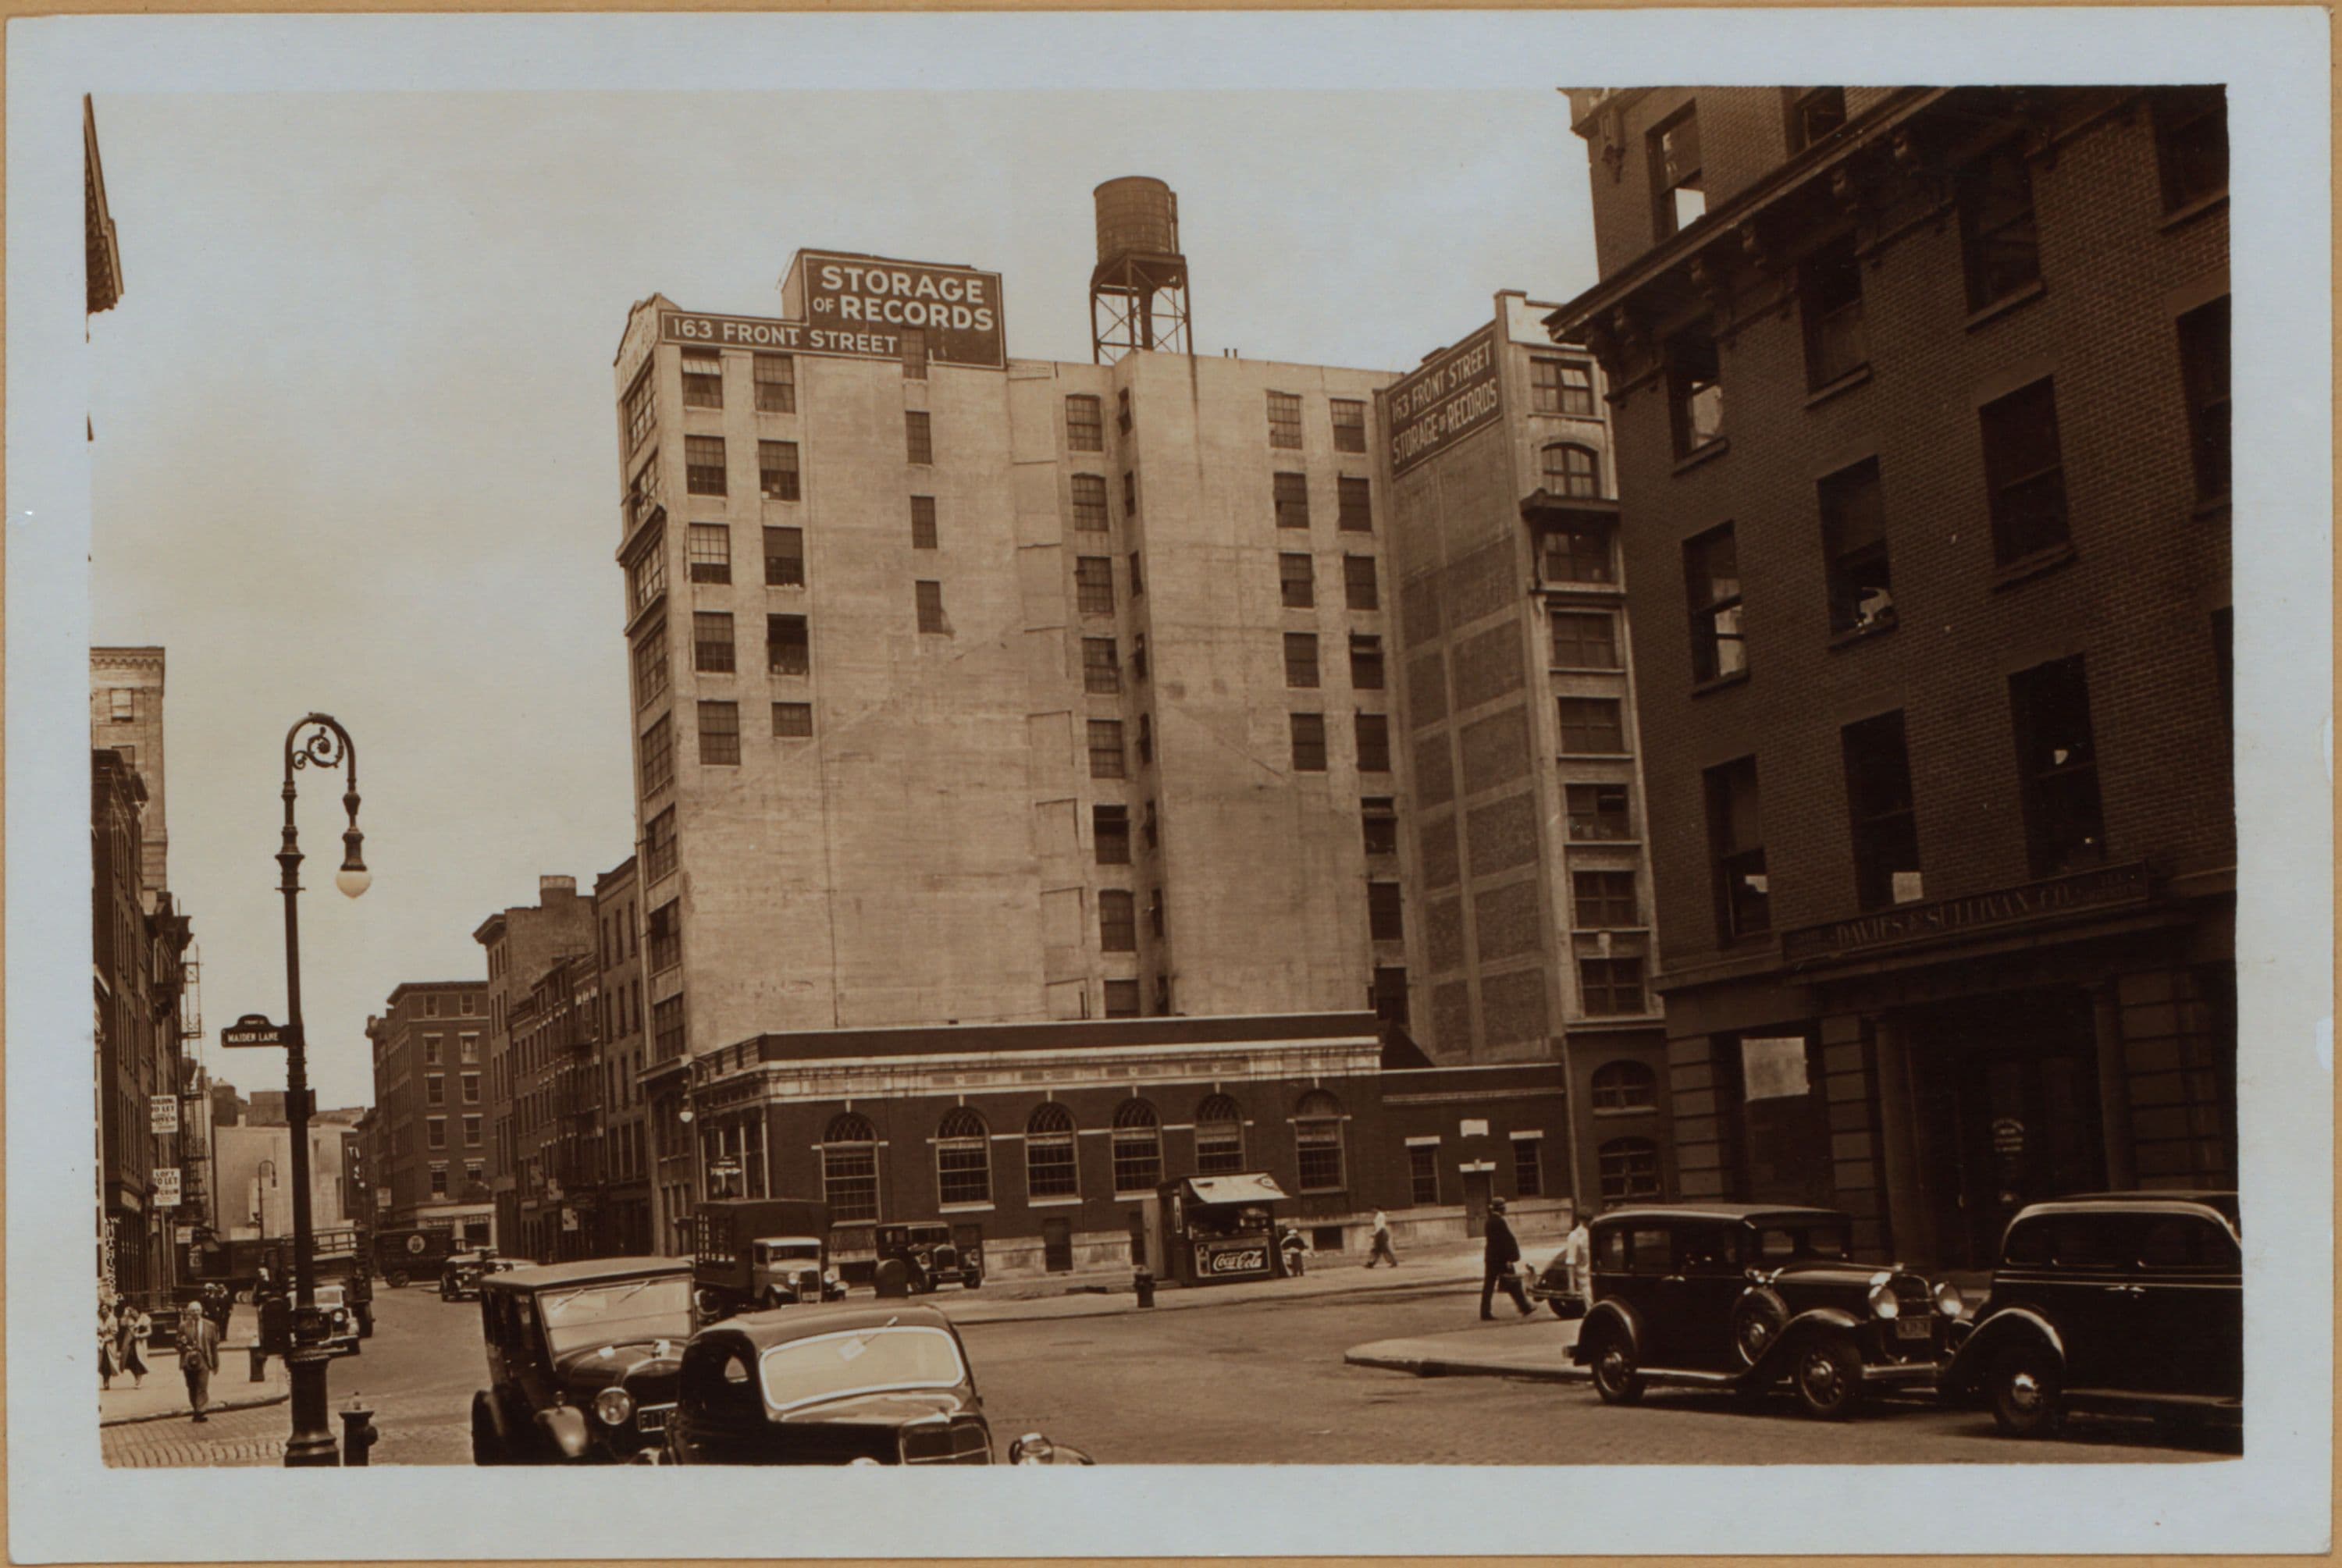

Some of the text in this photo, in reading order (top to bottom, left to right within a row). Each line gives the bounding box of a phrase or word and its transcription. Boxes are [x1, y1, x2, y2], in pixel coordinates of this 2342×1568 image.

[820, 265, 985, 304] STORAGE
[813, 295, 995, 332] OF RECORDS
[673, 318, 898, 354] 163 FRONT STREET
[1392, 340, 1491, 423] 163 FRONT STREET
[1393, 413, 1440, 465] STORAGE
[1447, 377, 1498, 434] RECORDS
[227, 1032, 279, 1043] MAIDEN LANE
[164, 1176, 178, 1186] LET
